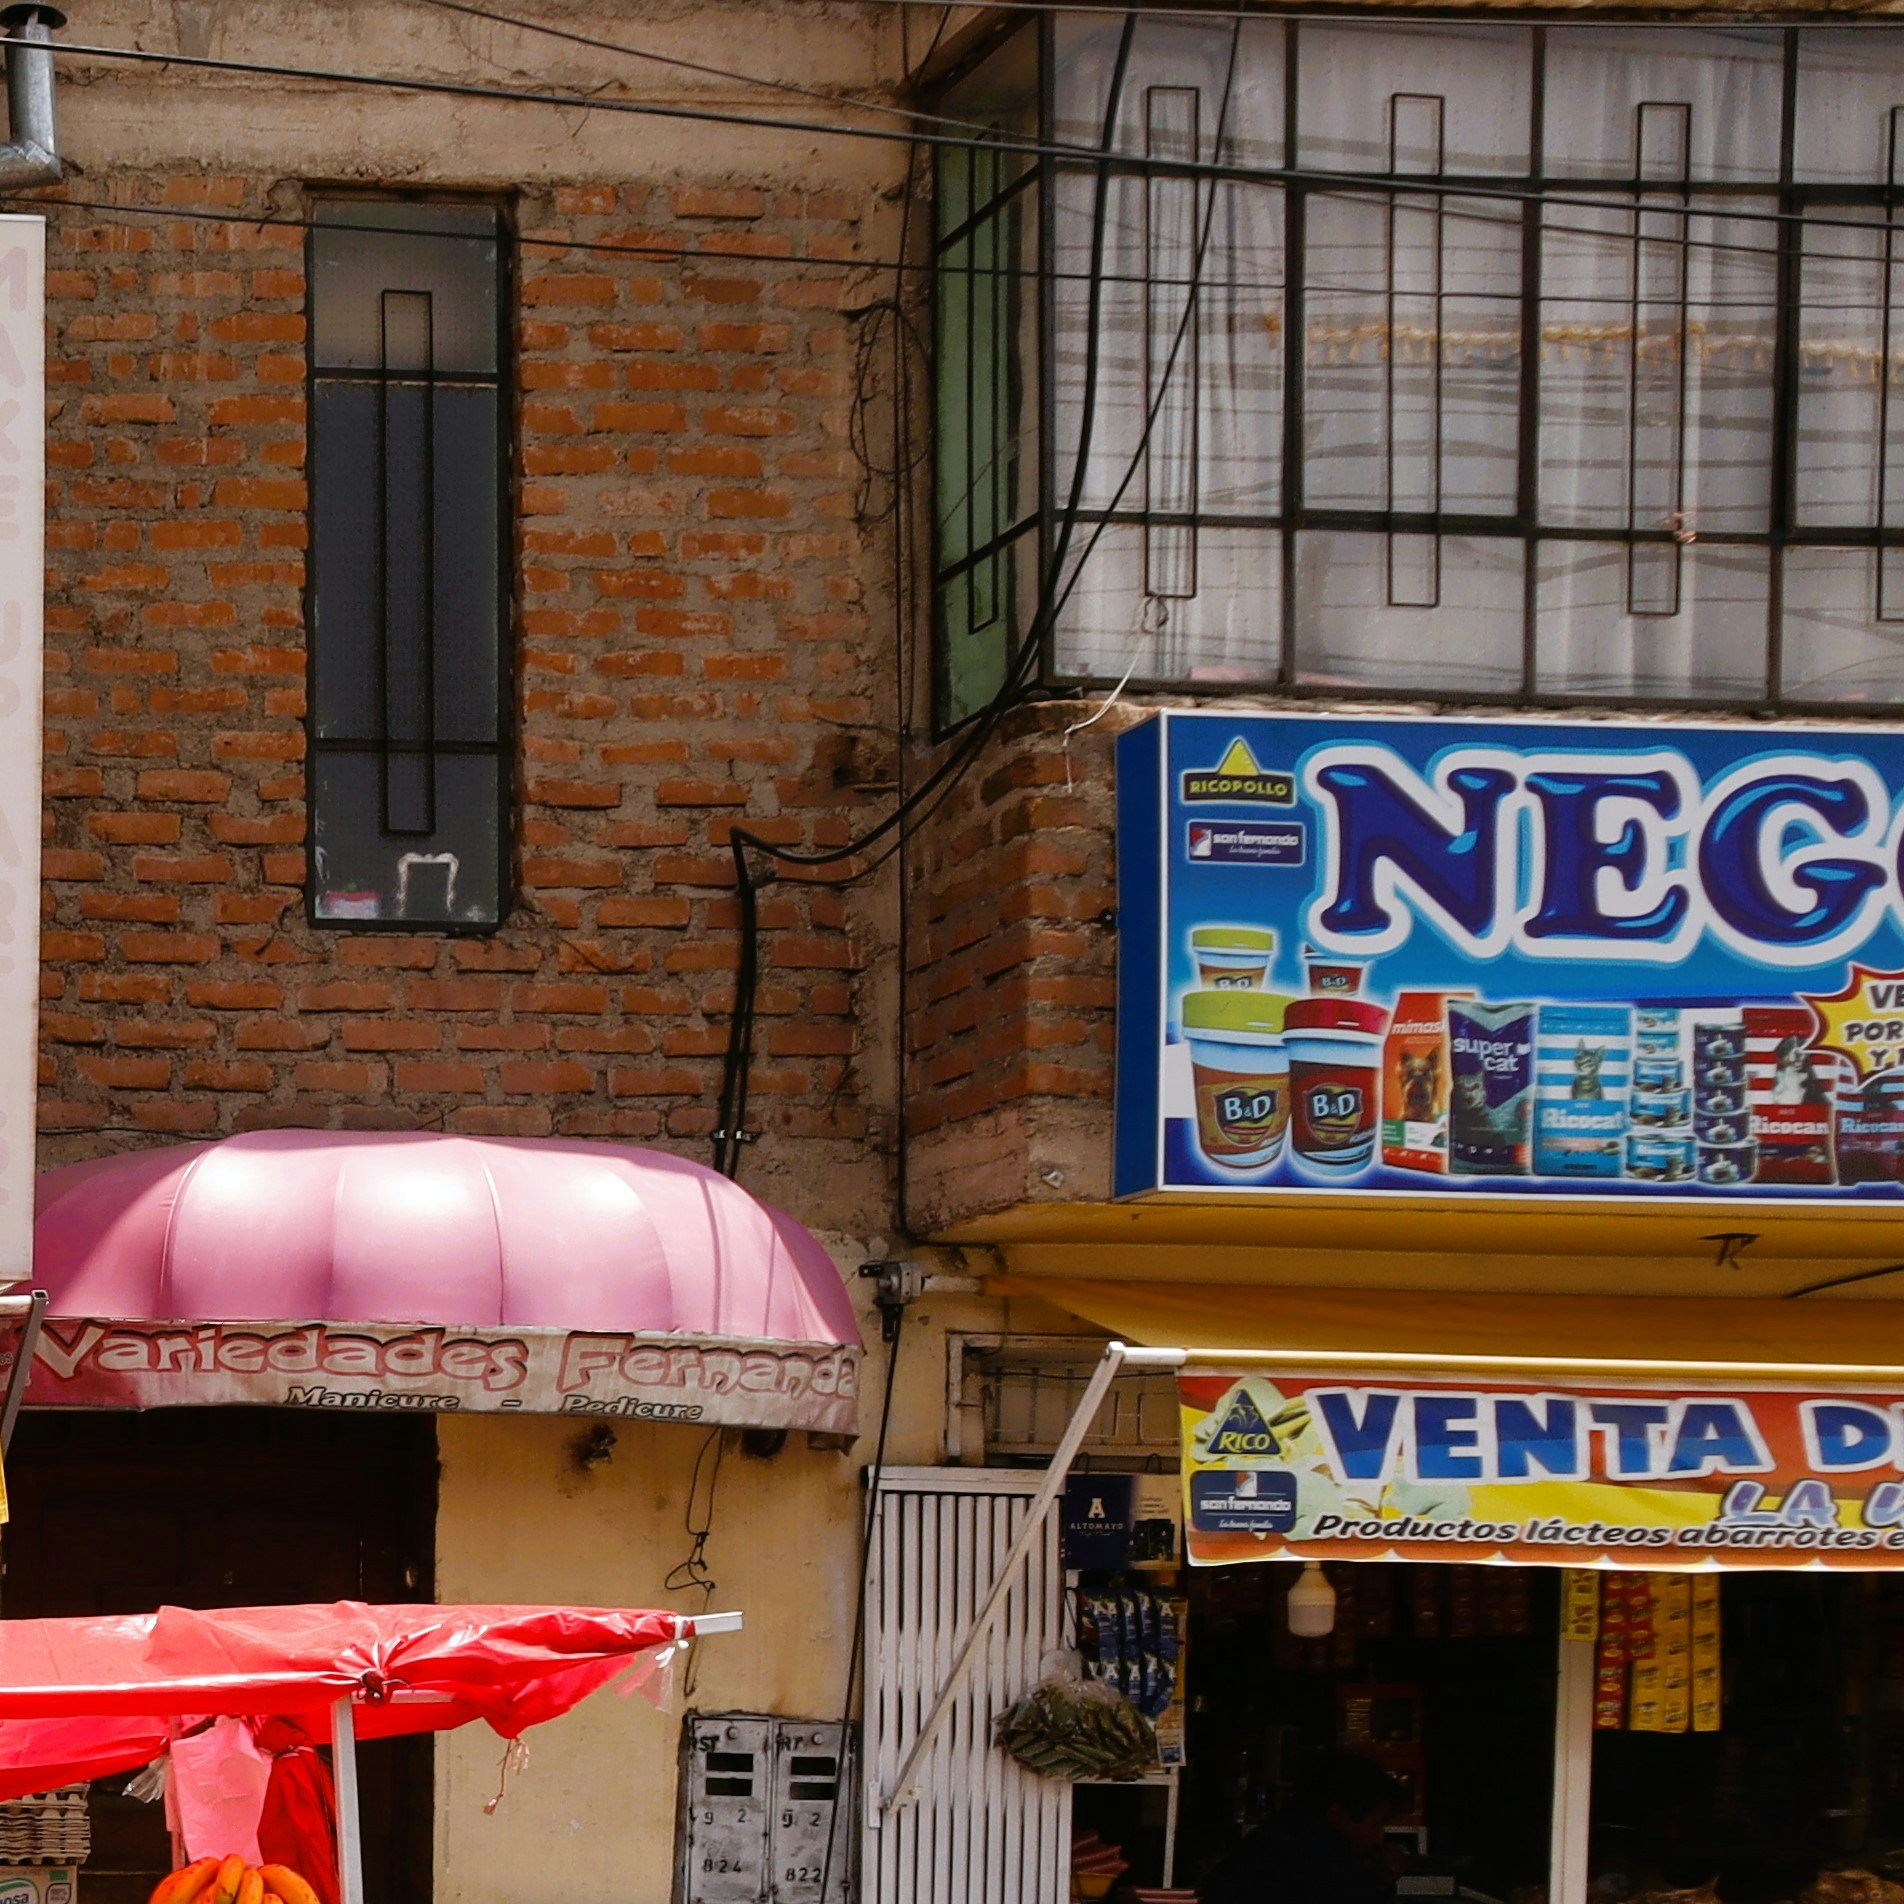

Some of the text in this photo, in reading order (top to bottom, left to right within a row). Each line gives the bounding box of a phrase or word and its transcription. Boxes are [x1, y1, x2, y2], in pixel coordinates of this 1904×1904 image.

[1190, 780, 1288, 796] RICOPOLLO
[1315, 764, 1904, 942] NEG
[1454, 1037, 1513, 1061] super
[1870, 1049, 1890, 1066] Y
[1484, 1056, 1519, 1072] cat
[1224, 1096, 1270, 1121] B&D
[1313, 1095, 1355, 1117] B&D
[34, 1322, 858, 1398] Variedades Fernanda
[287, 1386, 704, 1421] Manicure Pedicure
[1219, 1432, 1271, 1452] RICO
[1310, 1387, 1774, 1482] VENTA
[1718, 1480, 1839, 1528] LA
[1312, 1514, 1882, 1547] Productos lácteos abarrotes
[738, 1809, 746, 1823] 2
[810, 1813, 820, 1827] 2
[703, 1859, 742, 1873] 824
[786, 1868, 821, 1882] 822
